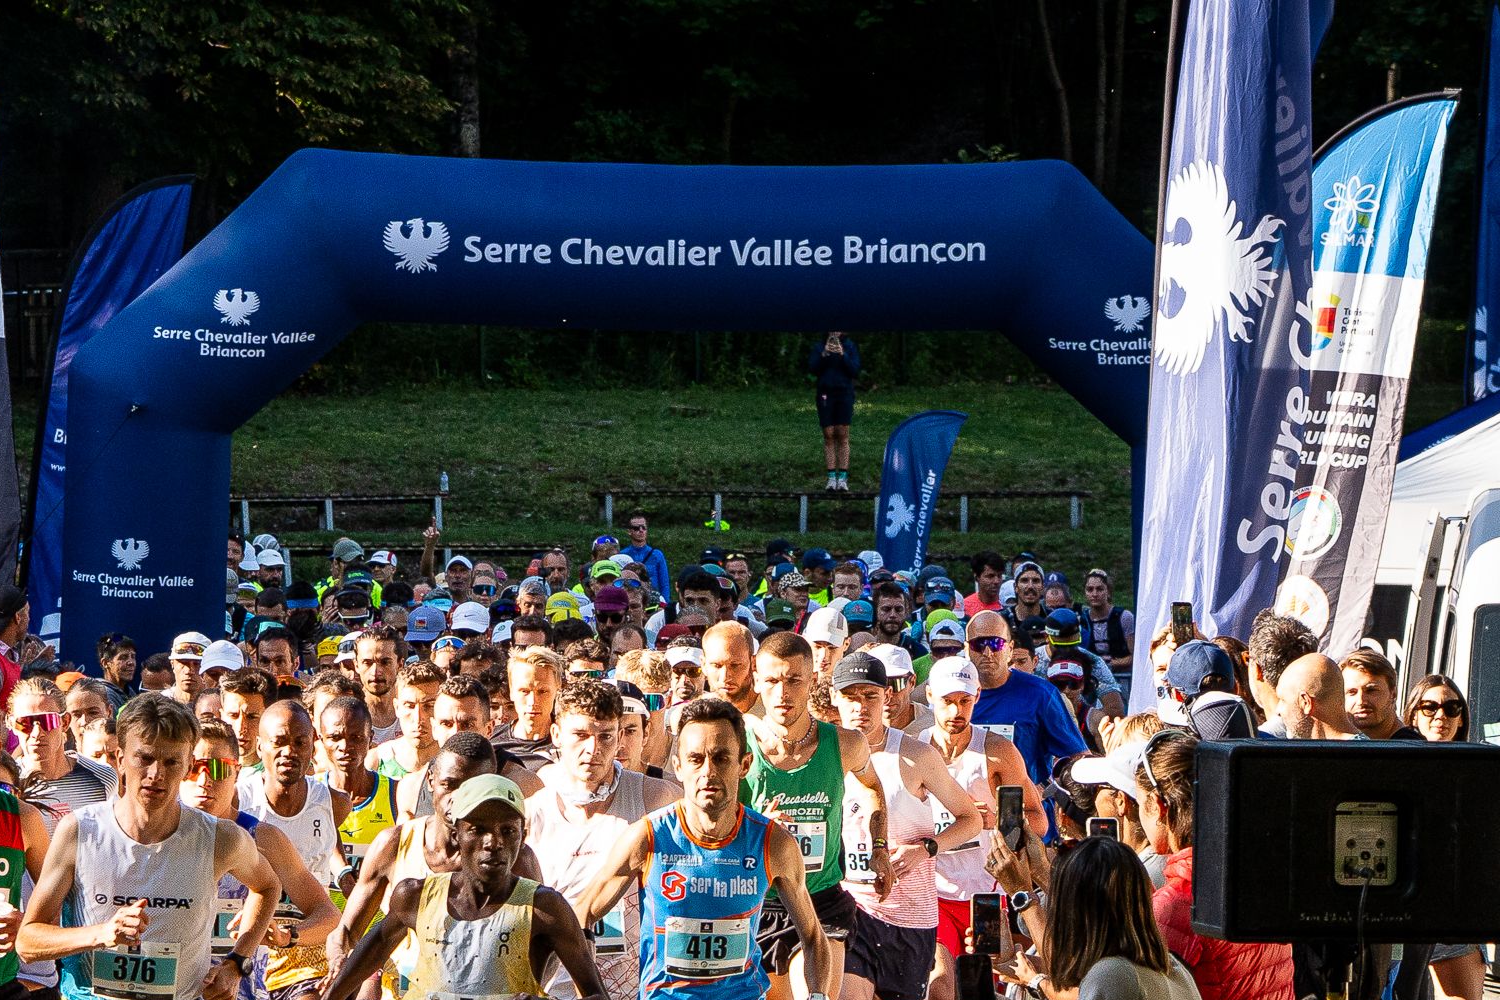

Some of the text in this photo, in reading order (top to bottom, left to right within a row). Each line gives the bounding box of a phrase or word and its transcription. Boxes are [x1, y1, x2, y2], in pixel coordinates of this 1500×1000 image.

[464, 234, 986, 267] Serre Chevalier Vallée Briançon
[153, 326, 316, 344] Serre Chevalier Vallée
[1048, 337, 1153, 352] Serre Chevalie
[1330, 450, 1368, 470] CUP
[1238, 384, 1310, 564] Serre
[72, 570, 194, 587] Serre Chevalier Vallée
[848, 852, 870, 872] 35
[690, 876, 712, 894] ser
[730, 876, 758, 898] plast
[685, 936, 728, 959] 413
[113, 956, 156, 984] 376
